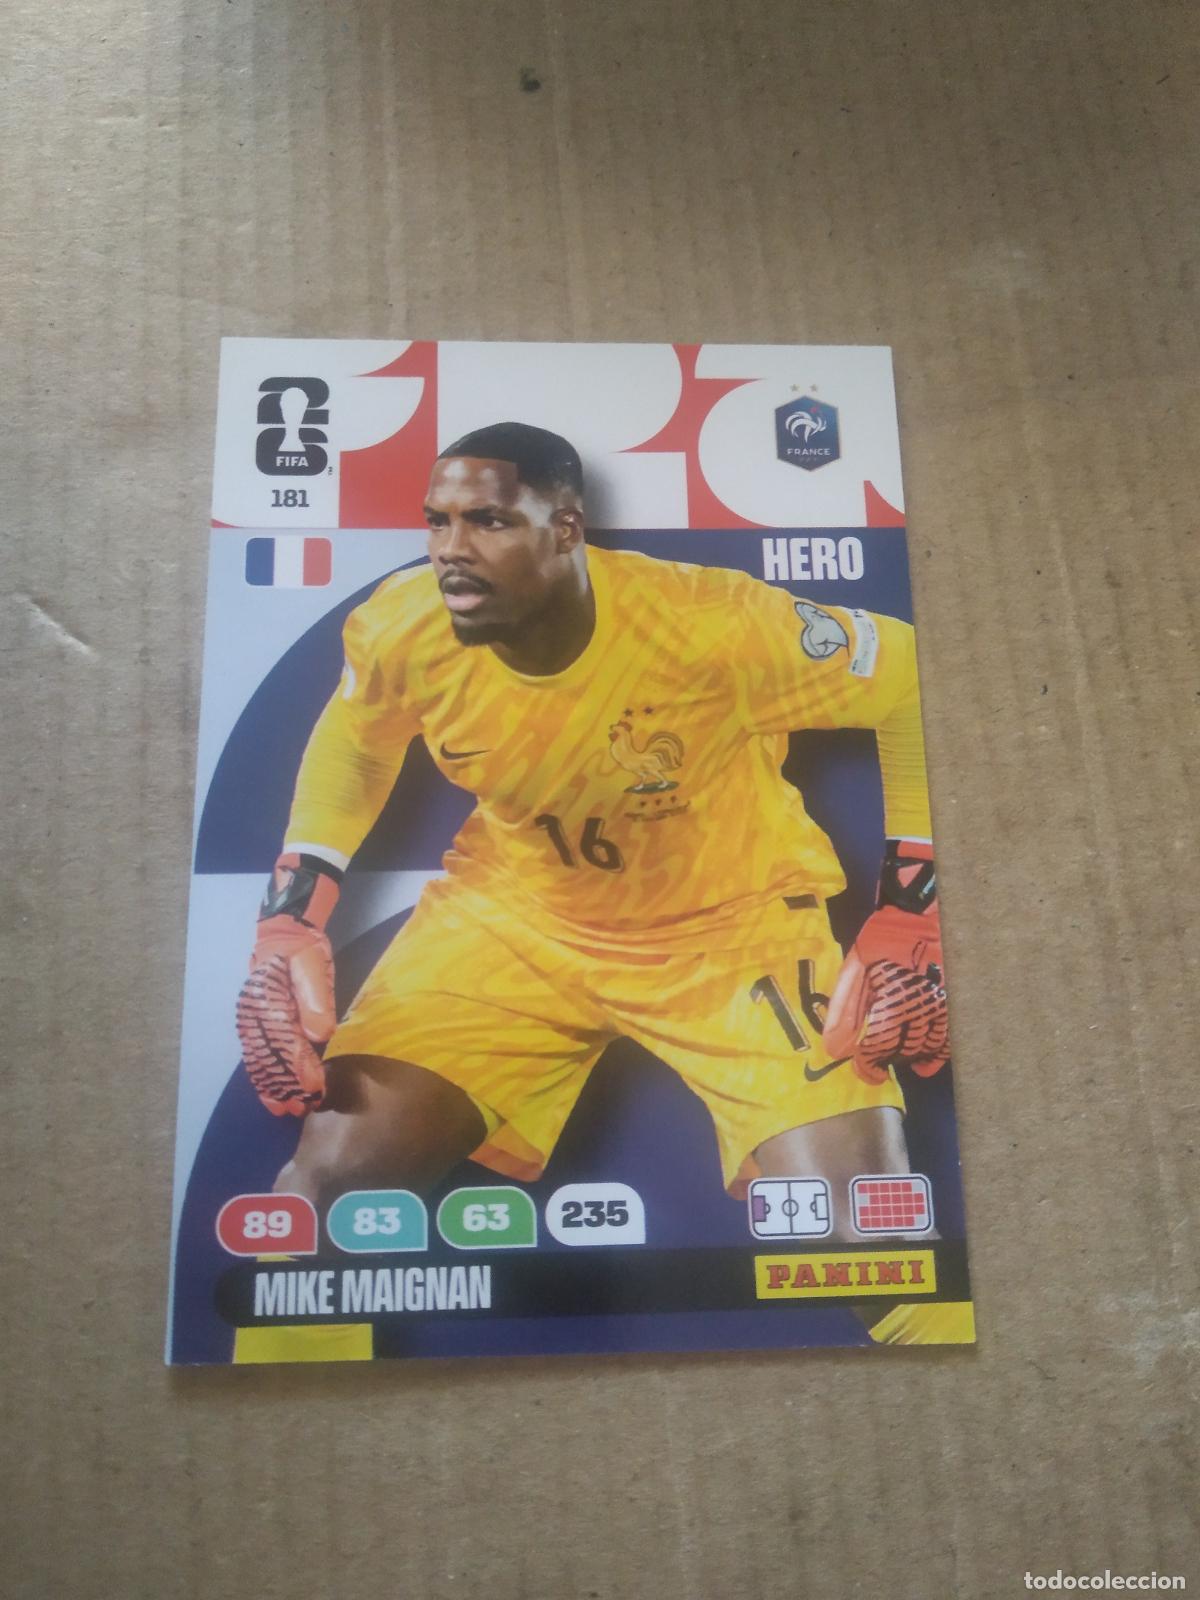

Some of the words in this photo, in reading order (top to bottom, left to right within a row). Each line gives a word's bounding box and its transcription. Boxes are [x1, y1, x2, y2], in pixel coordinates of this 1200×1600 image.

[275, 456, 309, 467] FIFA
[786, 448, 831, 456] FRANCE
[271, 489, 310, 508] 181
[762, 536, 864, 581] HERO
[534, 813, 625, 873] 16
[242, 1210, 292, 1239] 89
[353, 1207, 401, 1236] 83
[462, 1203, 510, 1232] 63
[561, 1200, 629, 1228] 235
[254, 1270, 336, 1316] MIKE
[341, 1265, 492, 1314] MAIGNAN
[766, 1260, 926, 1289] PANINI
